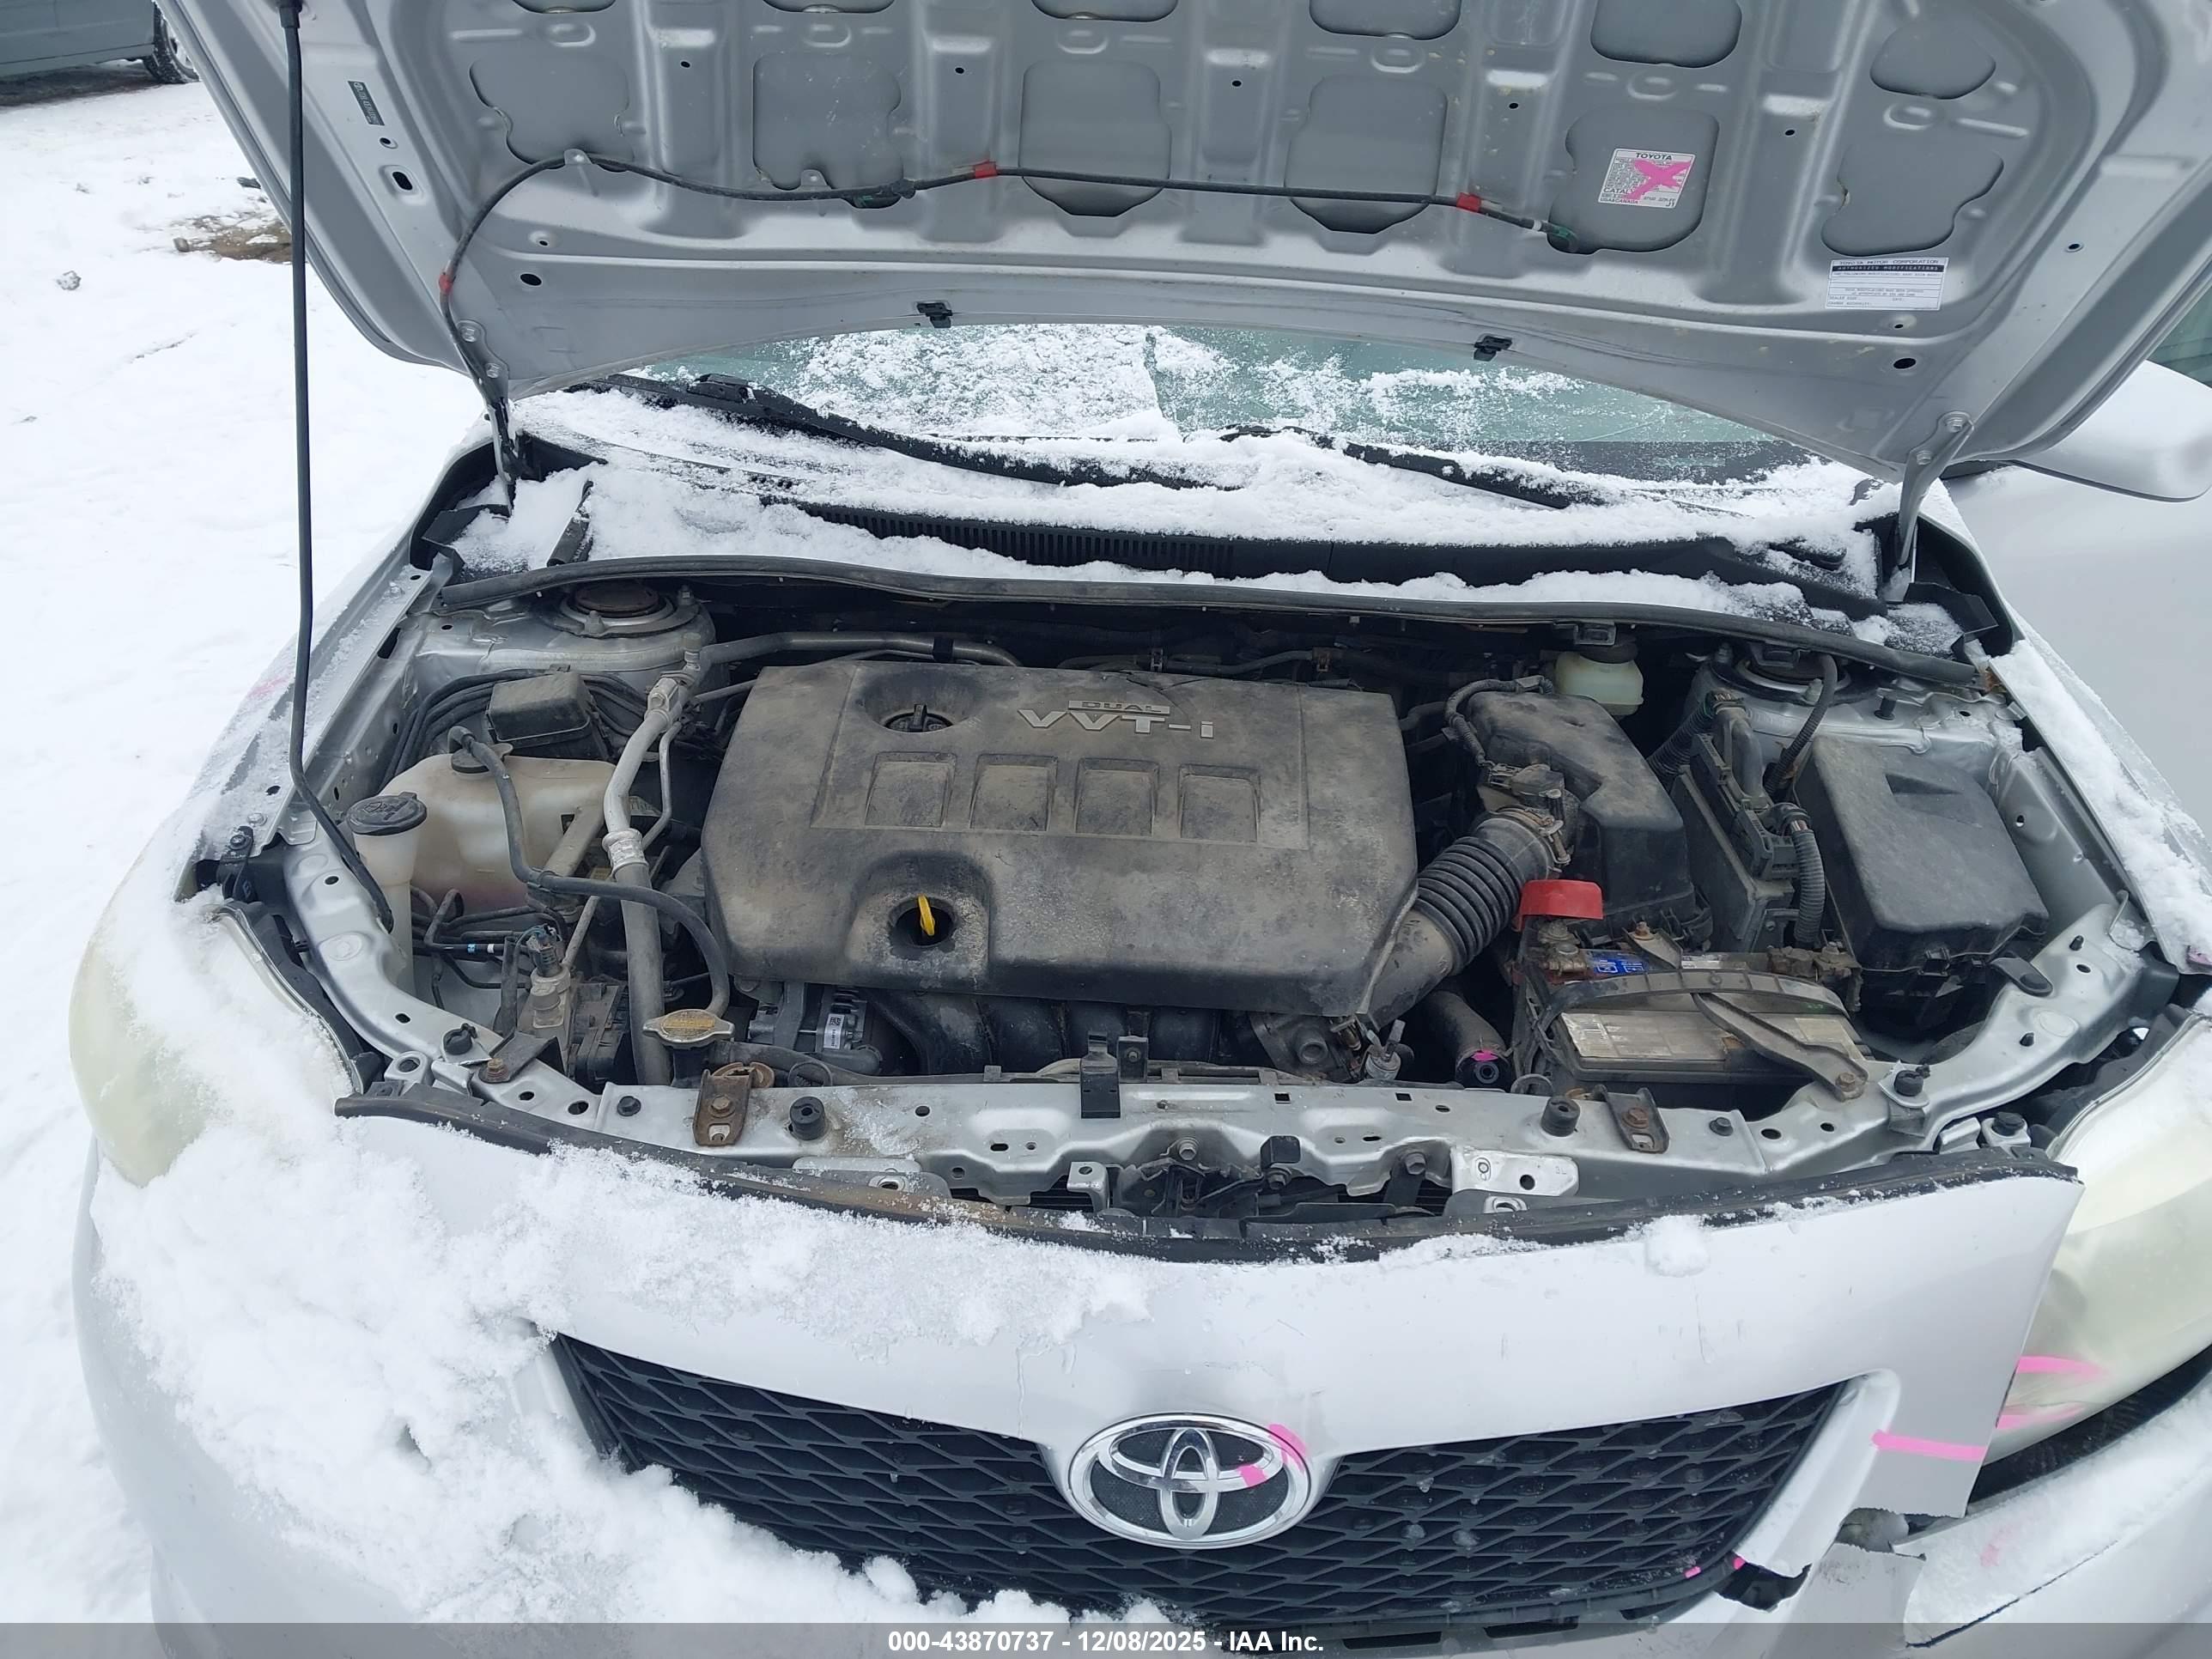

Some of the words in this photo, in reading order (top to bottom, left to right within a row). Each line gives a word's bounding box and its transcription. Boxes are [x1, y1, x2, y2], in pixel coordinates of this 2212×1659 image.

[1635, 152, 1673, 161] TOYOTA
[1081, 701, 1162, 713] DUAL
[1018, 708, 1215, 739] VVT-i
